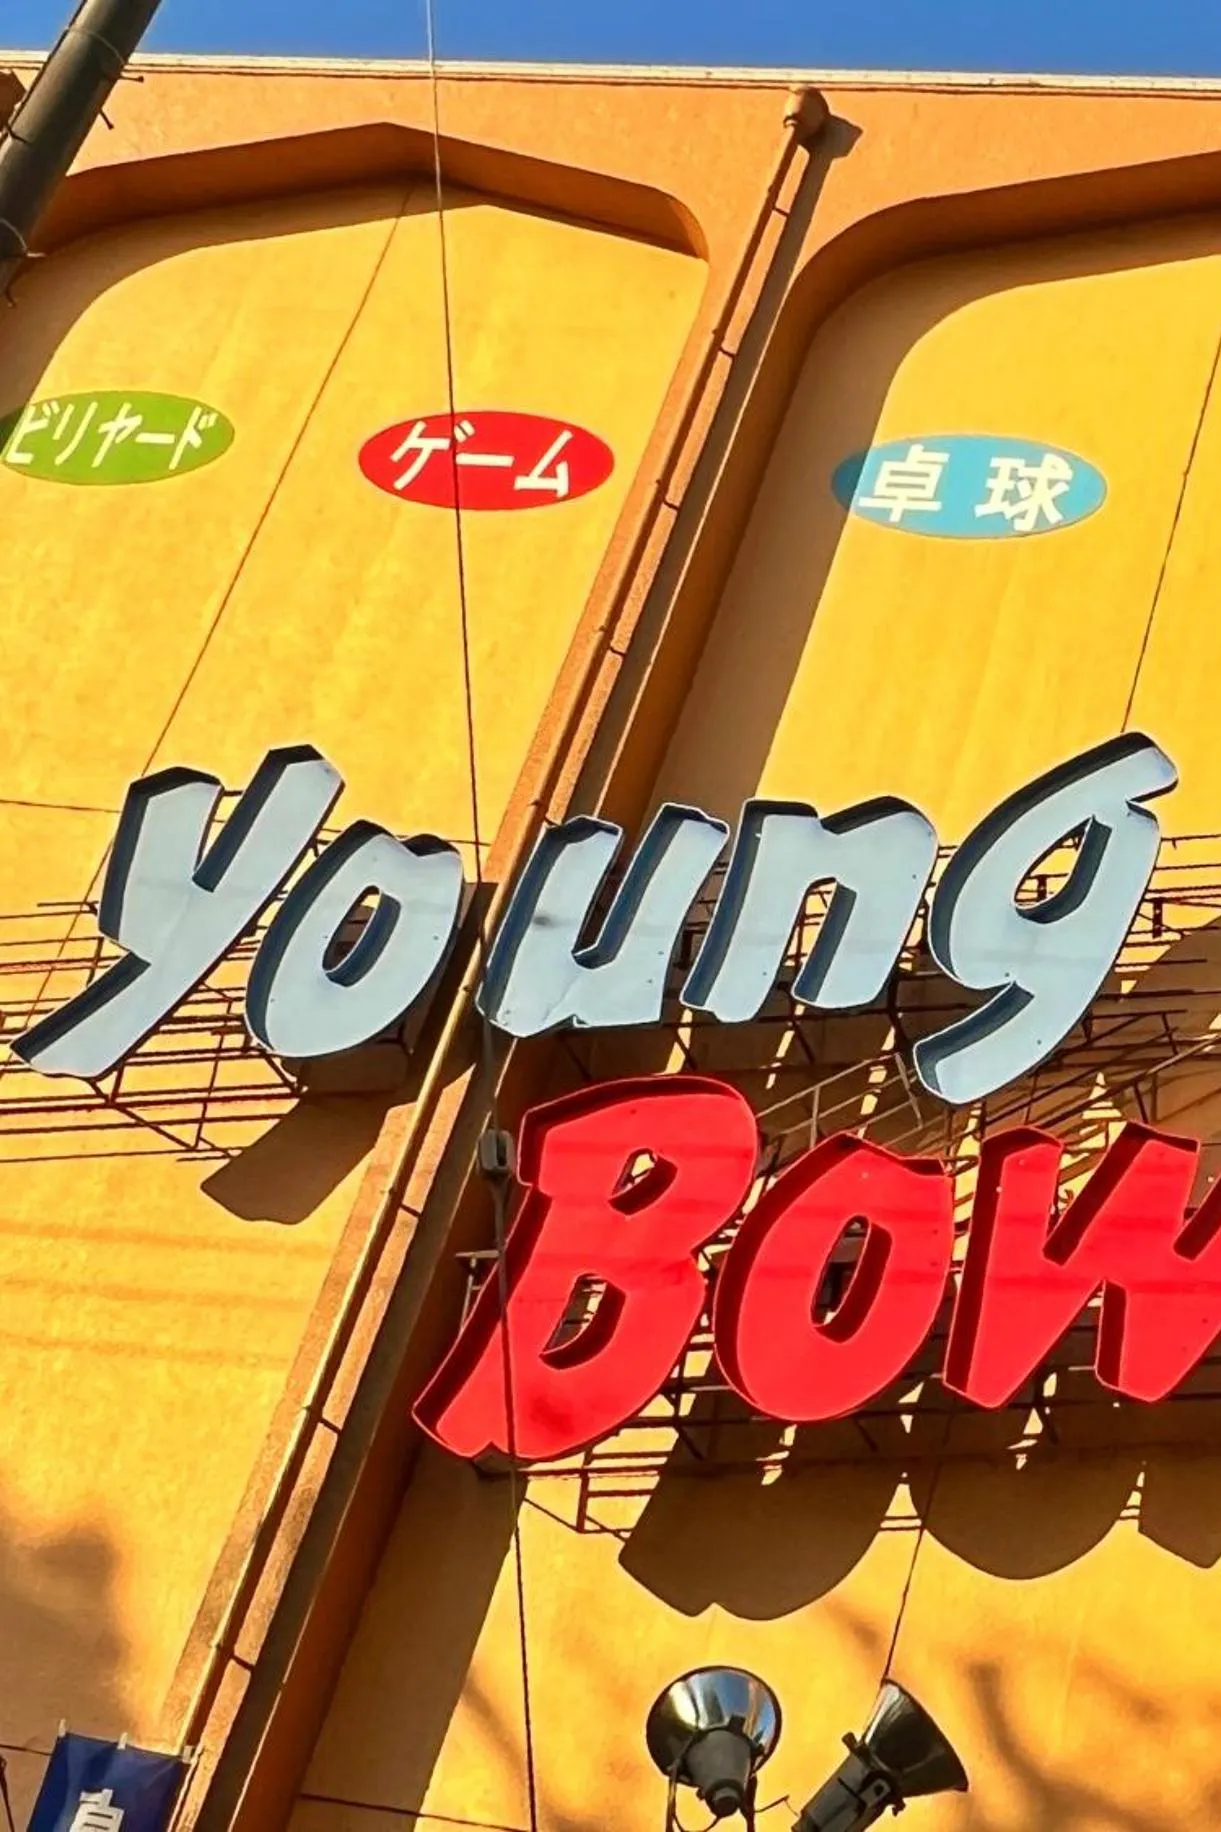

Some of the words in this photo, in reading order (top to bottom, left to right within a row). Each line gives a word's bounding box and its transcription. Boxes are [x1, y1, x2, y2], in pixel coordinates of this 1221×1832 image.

[5, 401, 219, 470] ビリヤード
[390, 419, 573, 498] ゲーム
[857, 443, 1074, 532] 卓球
[10, 731, 1178, 1104] Young
